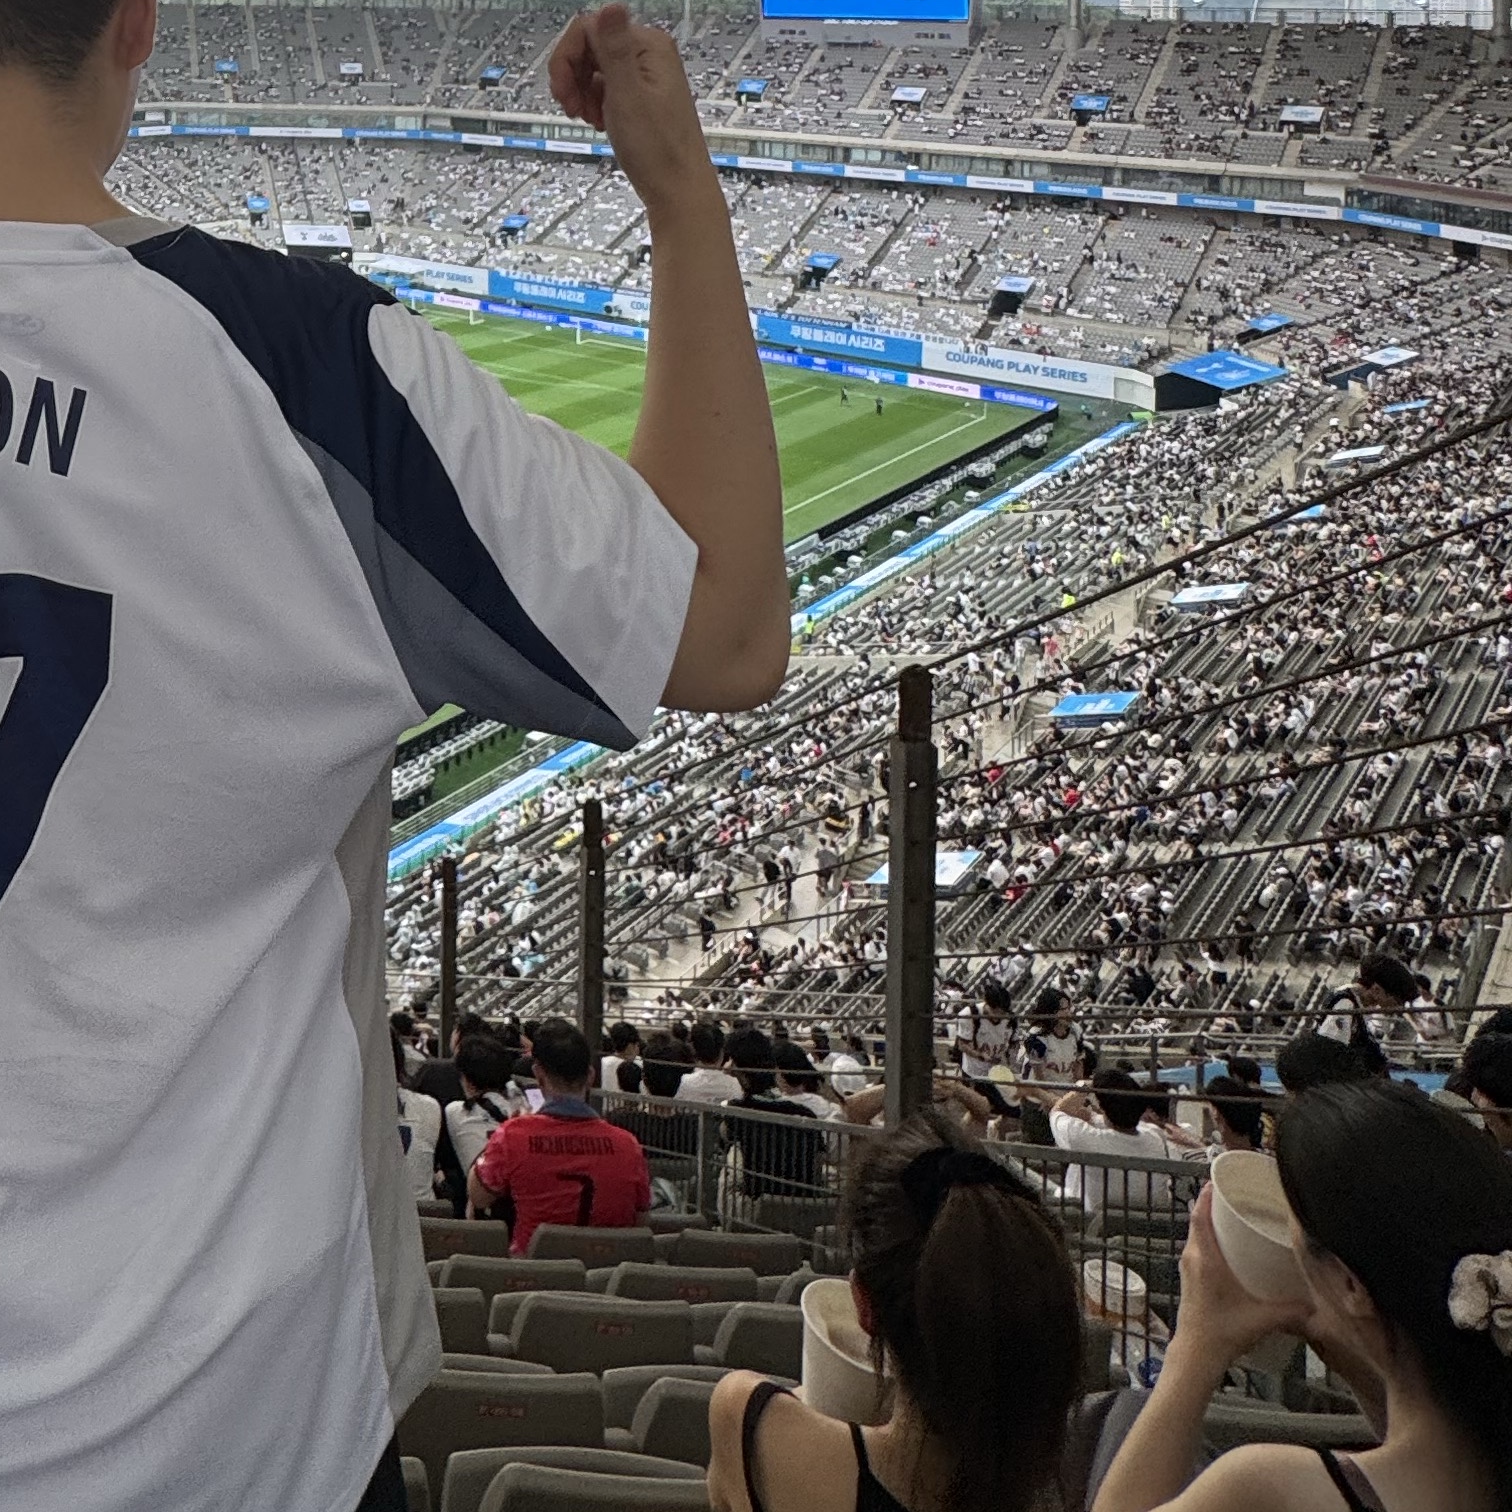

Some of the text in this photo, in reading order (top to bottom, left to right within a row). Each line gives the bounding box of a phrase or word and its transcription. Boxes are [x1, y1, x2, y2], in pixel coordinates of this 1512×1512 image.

[789, 324, 848, 347] 쿠팡플레이
[848, 333, 886, 353] 시리즈
[945, 351, 1088, 383] COUPANG PLAY SERIES
[556, 1171, 596, 1226] 7
